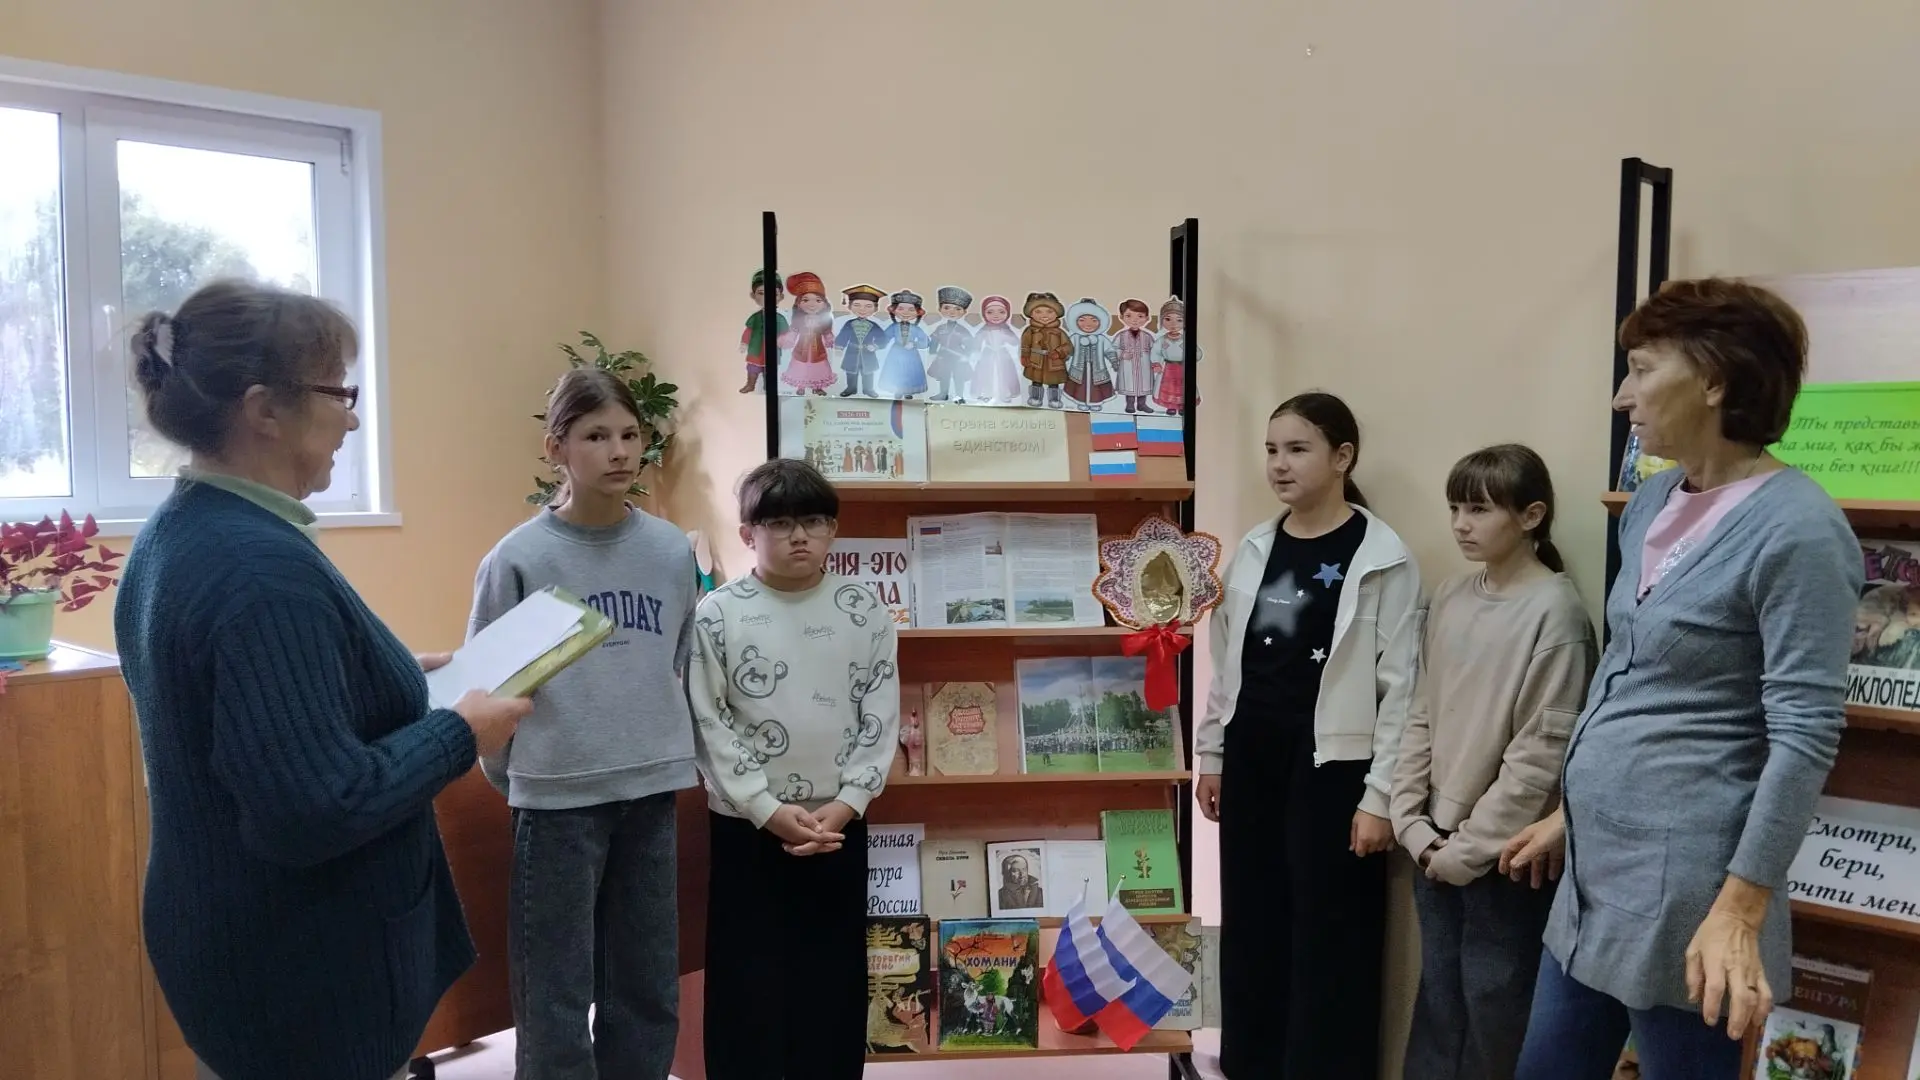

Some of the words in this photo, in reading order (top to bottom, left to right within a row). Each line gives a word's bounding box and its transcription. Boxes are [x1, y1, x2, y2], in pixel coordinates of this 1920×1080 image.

[941, 418, 995, 431] Страна
[1001, 418, 1056, 430] сильна
[1791, 417, 1827, 430] Ты
[954, 438, 1045, 453] единством!
[1802, 441, 1837, 453] миг,
[1845, 440, 1877, 454] как
[1879, 437, 1902, 451] бы
[1829, 458, 1855, 472] без
[1861, 460, 1920, 476] книг!!!
[620, 591, 662, 635] DAY
[1806, 816, 1917, 855] Смотри,
[1819, 848, 1884, 881] бери,
[1787, 880, 1854, 904] очти
[867, 896, 918, 915] России
[966, 956, 1017, 968] ХОМАНИ
